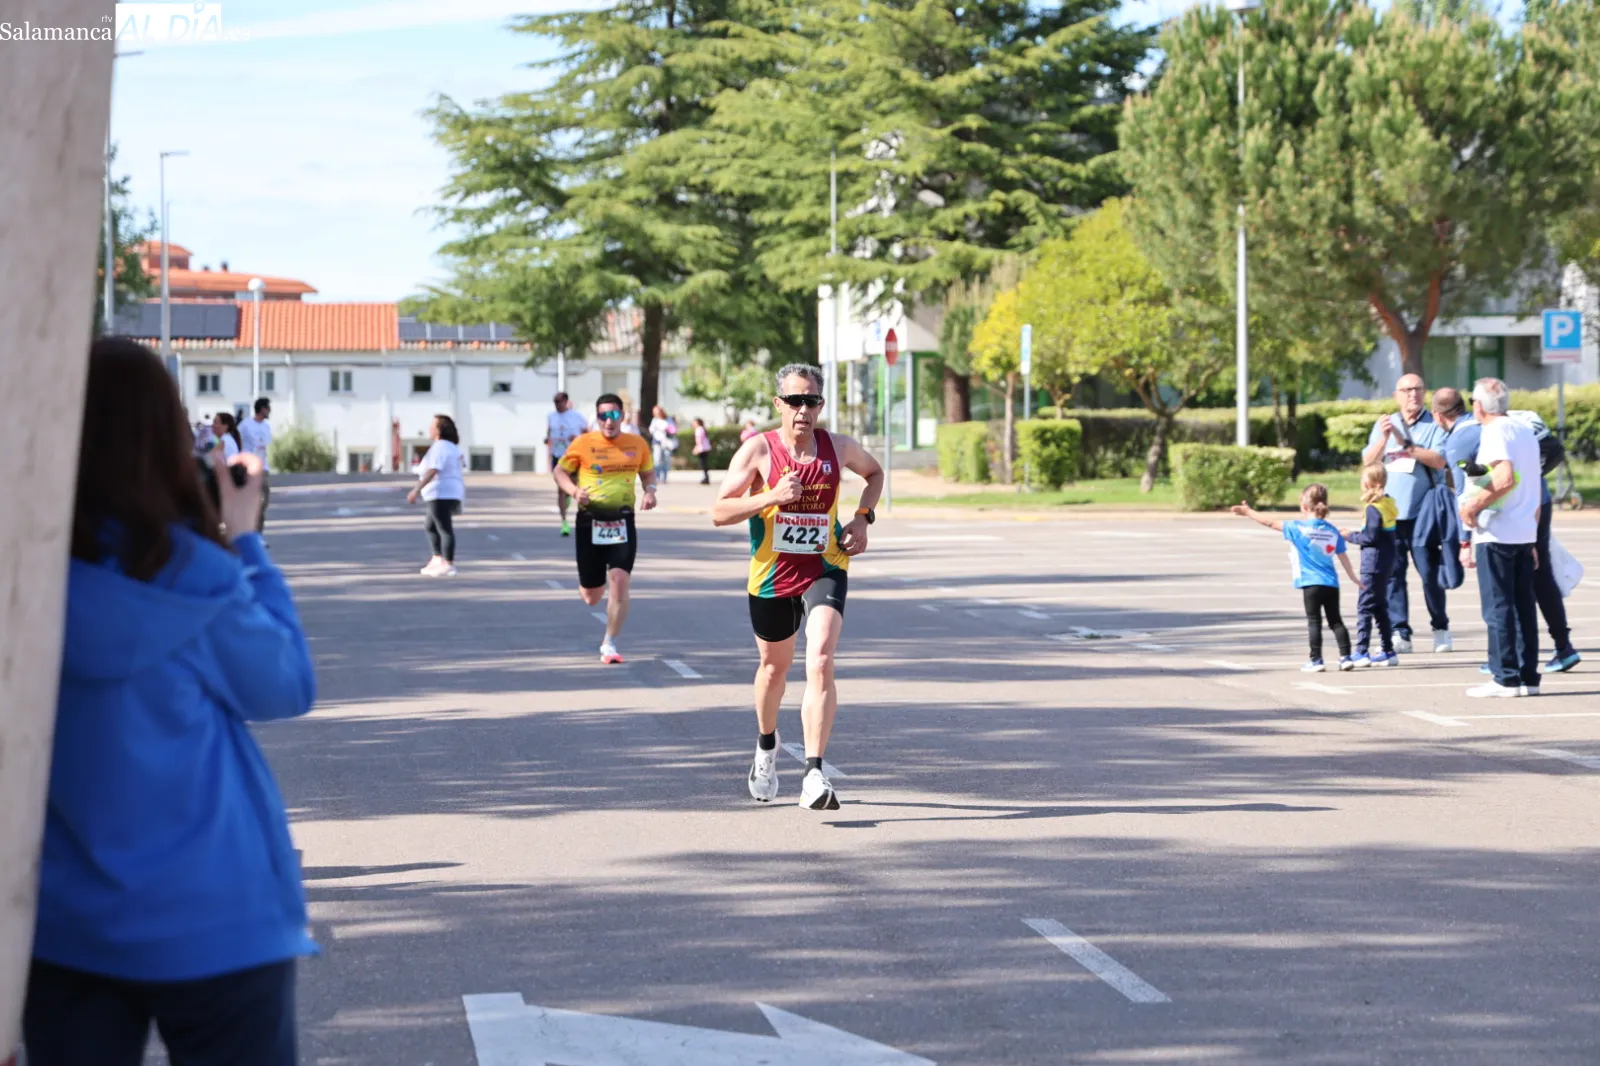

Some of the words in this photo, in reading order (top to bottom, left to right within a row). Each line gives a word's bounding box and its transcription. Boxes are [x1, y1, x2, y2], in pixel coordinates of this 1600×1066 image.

[1551, 316, 1574, 346] P
[787, 504, 799, 512] DE
[801, 502, 826, 511] TORO
[782, 526, 820, 545] 422
